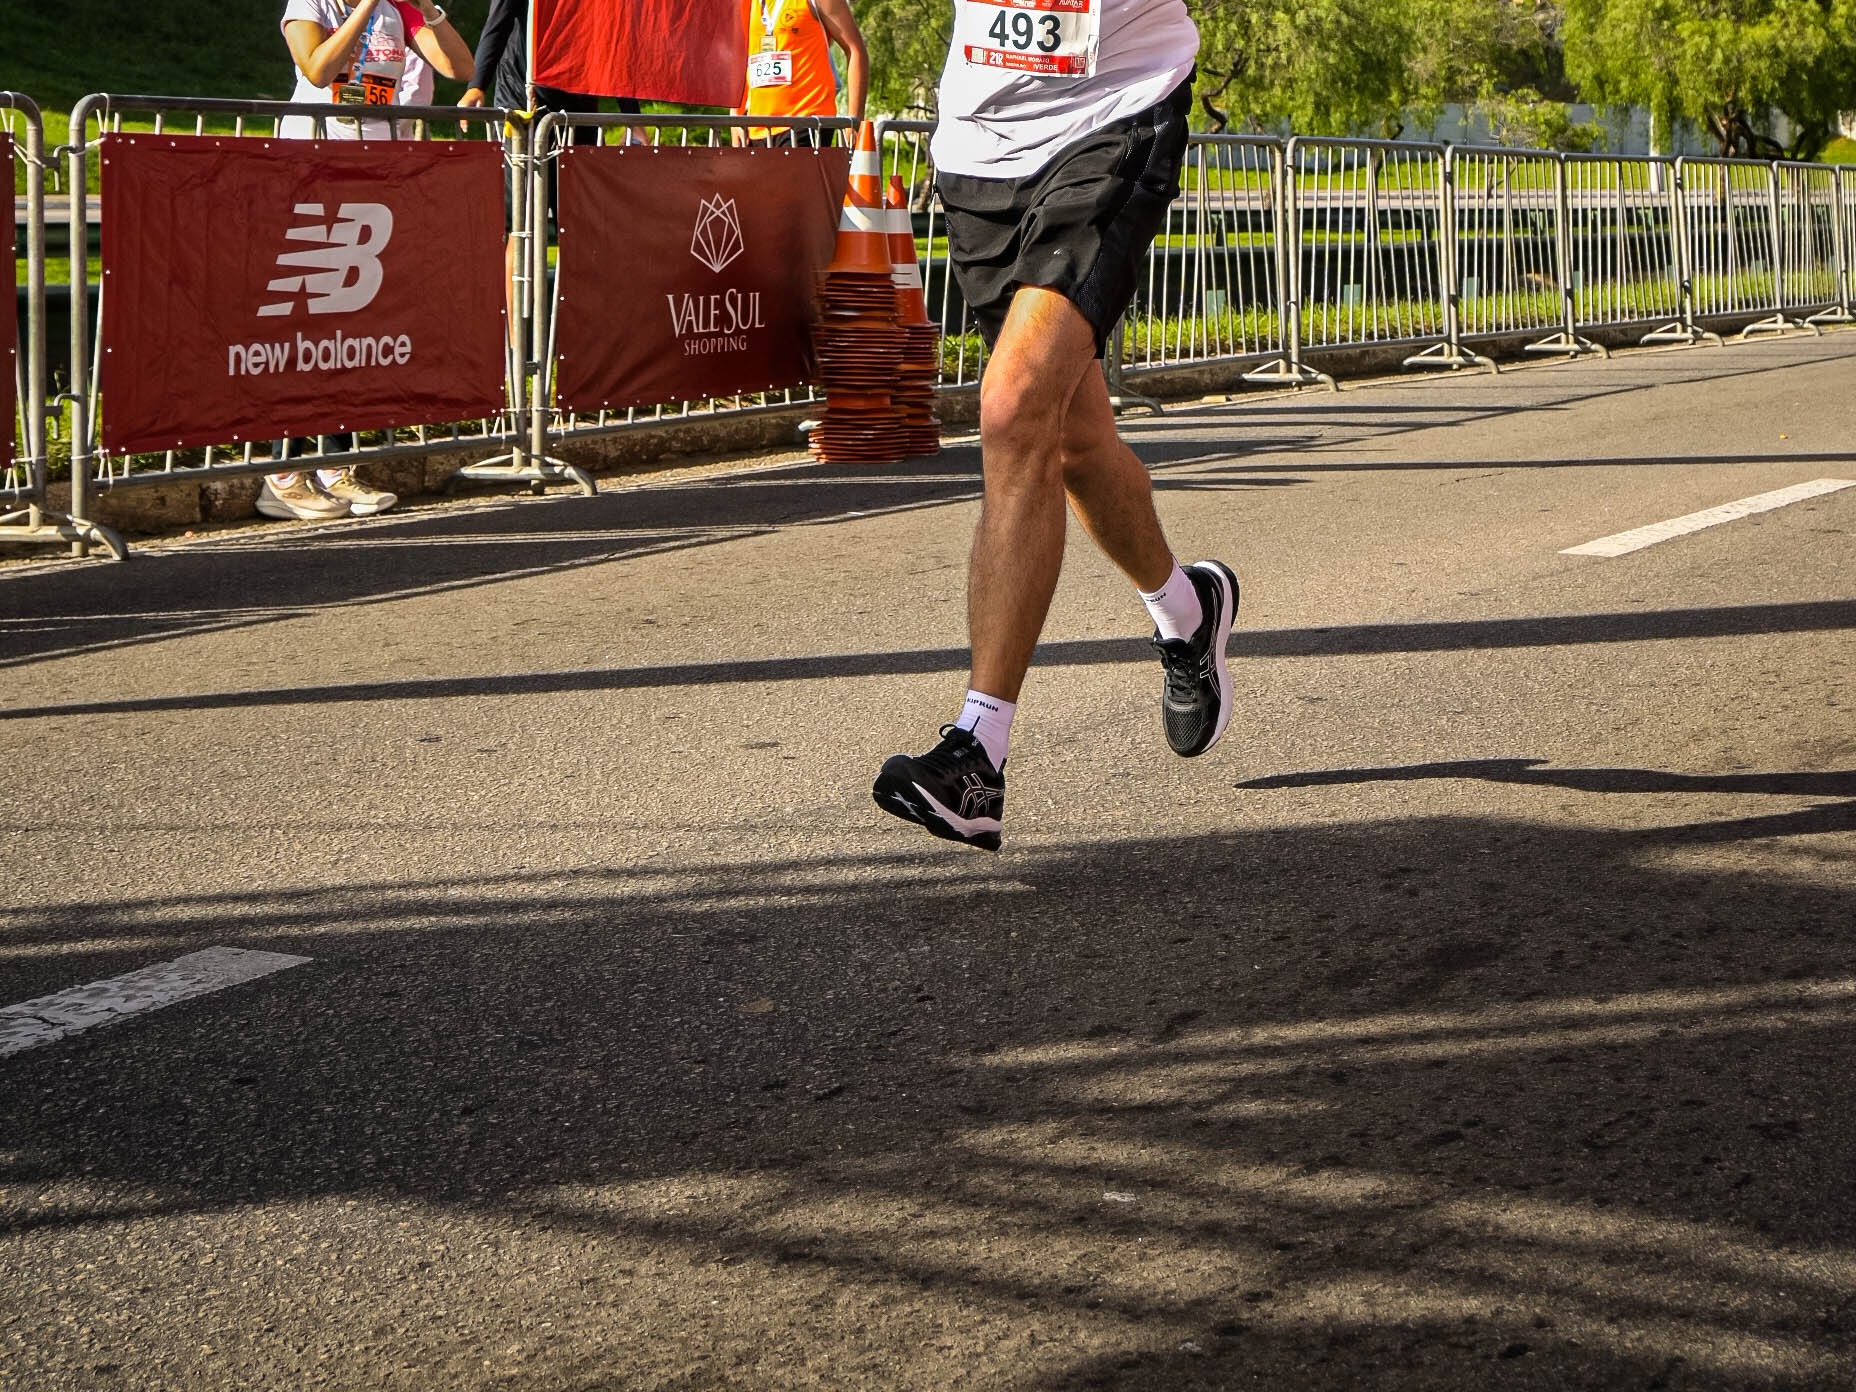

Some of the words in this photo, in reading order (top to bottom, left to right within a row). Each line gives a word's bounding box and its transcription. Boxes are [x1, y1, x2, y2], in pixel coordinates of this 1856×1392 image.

[988, 9, 1062, 53] 493
[756, 61, 782, 77] 625
[369, 86, 388, 105] 56
[665, 293, 720, 339] VALE
[723, 288, 766, 334] SUL
[228, 342, 290, 376] new
[296, 329, 412, 371] balance
[684, 335, 747, 356] SHOPPING
[966, 697, 999, 713] KIPRUN
